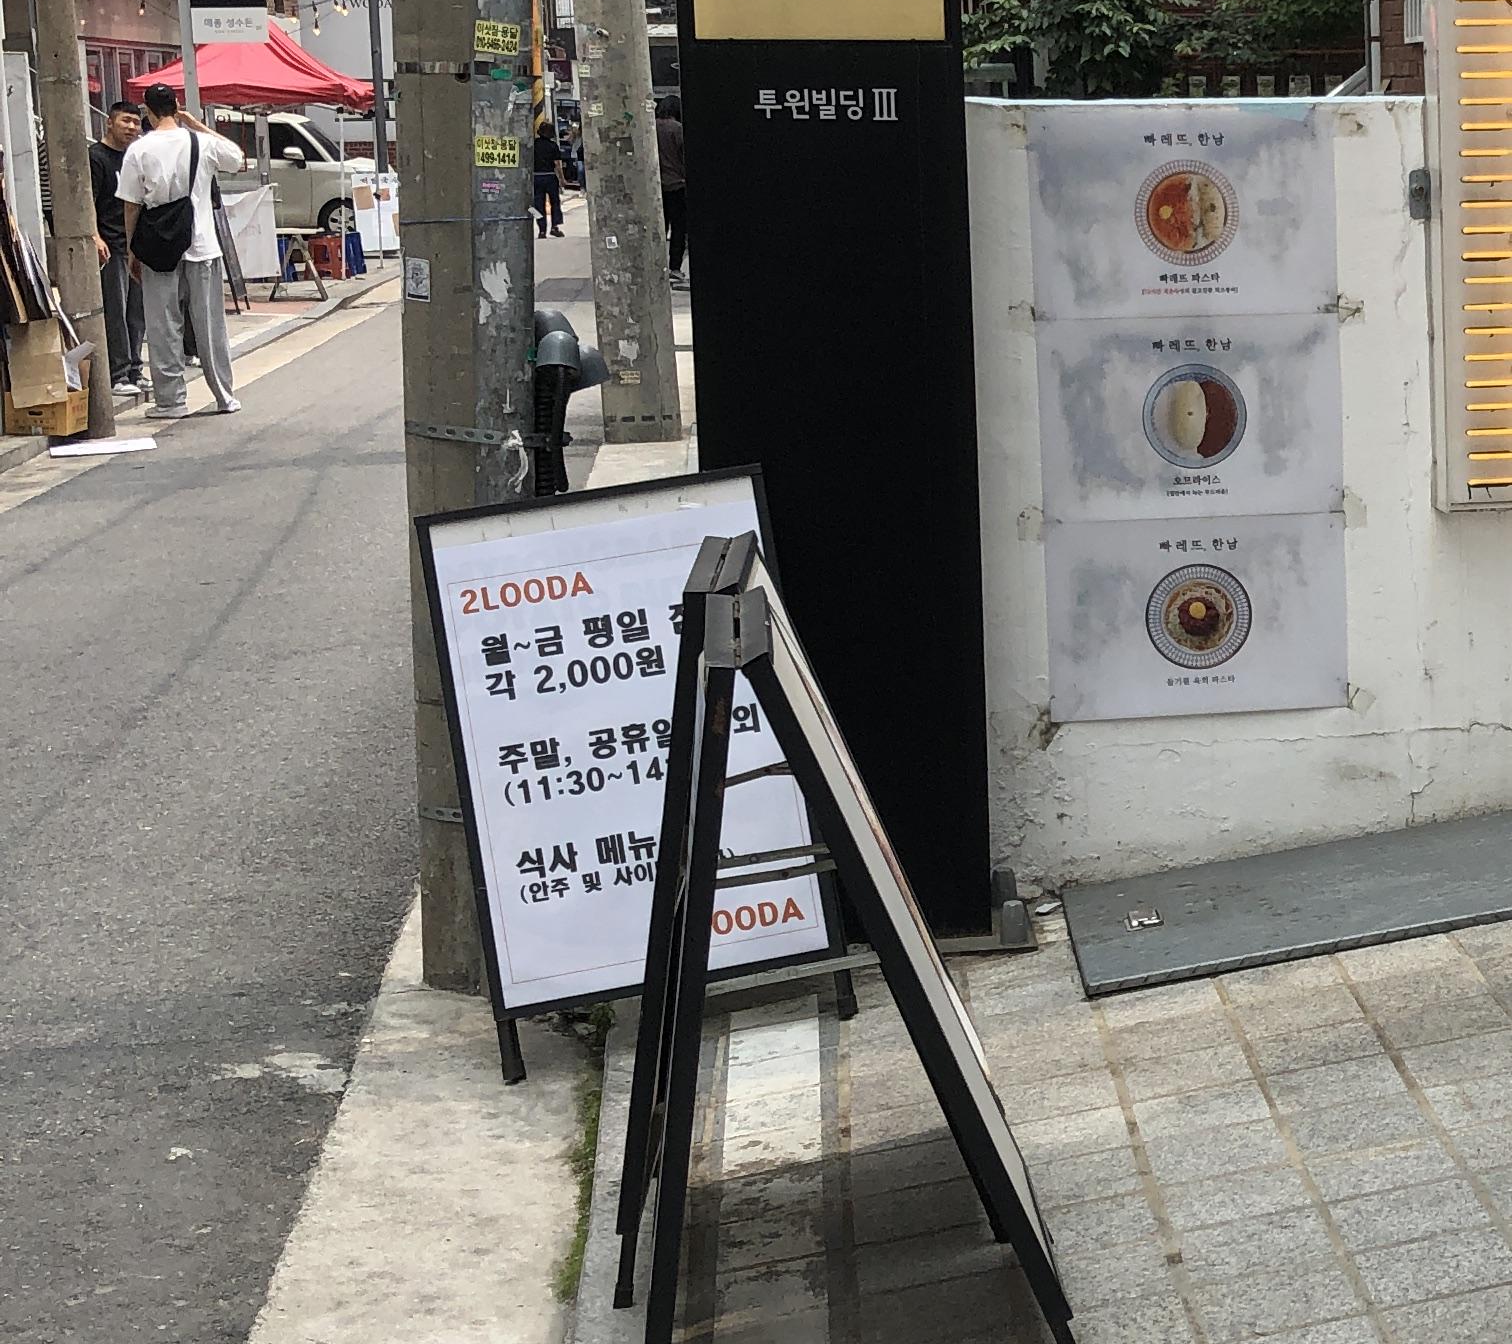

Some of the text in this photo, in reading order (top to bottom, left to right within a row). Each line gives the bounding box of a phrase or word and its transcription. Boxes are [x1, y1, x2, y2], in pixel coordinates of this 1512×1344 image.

[1198, 131, 1225, 147] 한남
[1205, 337, 1232, 352] 한남
[1212, 536, 1238, 552] 한남
[460, 571, 594, 615] 2LOODA
[480, 626, 563, 666] 월~금
[582, 609, 650, 648] 평일
[485, 644, 666, 701] 각 2,000원
[499, 737, 573, 776] 주말,
[588, 718, 672, 760] 공휴일
[516, 830, 657, 879] 식사 메뉴
[520, 878, 570, 904] (안주
[582, 872, 603, 894] 및
